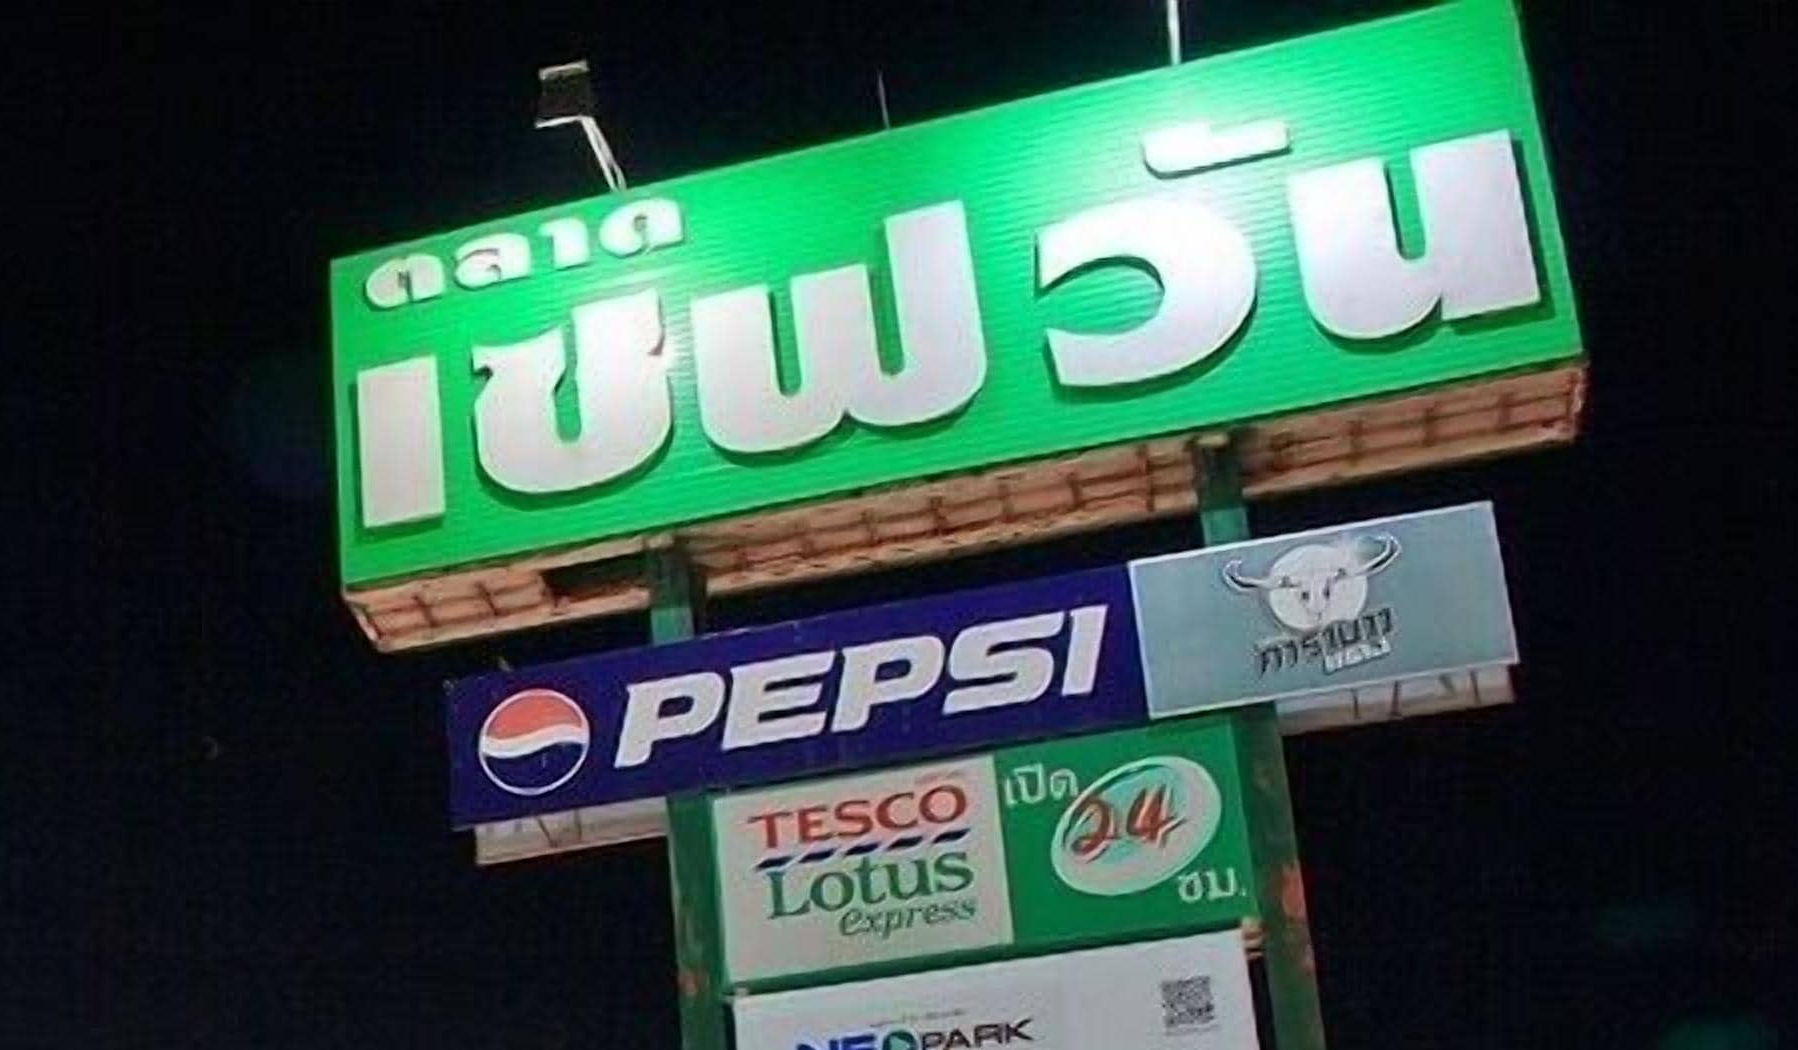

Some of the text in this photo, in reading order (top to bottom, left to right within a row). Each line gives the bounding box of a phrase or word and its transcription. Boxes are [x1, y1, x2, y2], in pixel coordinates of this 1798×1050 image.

[364, 196, 685, 311] ตลาด
[613, 604, 1108, 768] PEPSI
[748, 783, 968, 850] TESCO
[1002, 762, 1080, 808] เปิด
[1064, 784, 1188, 864] 24
[765, 848, 975, 922] Lotus
[838, 899, 977, 940] express
